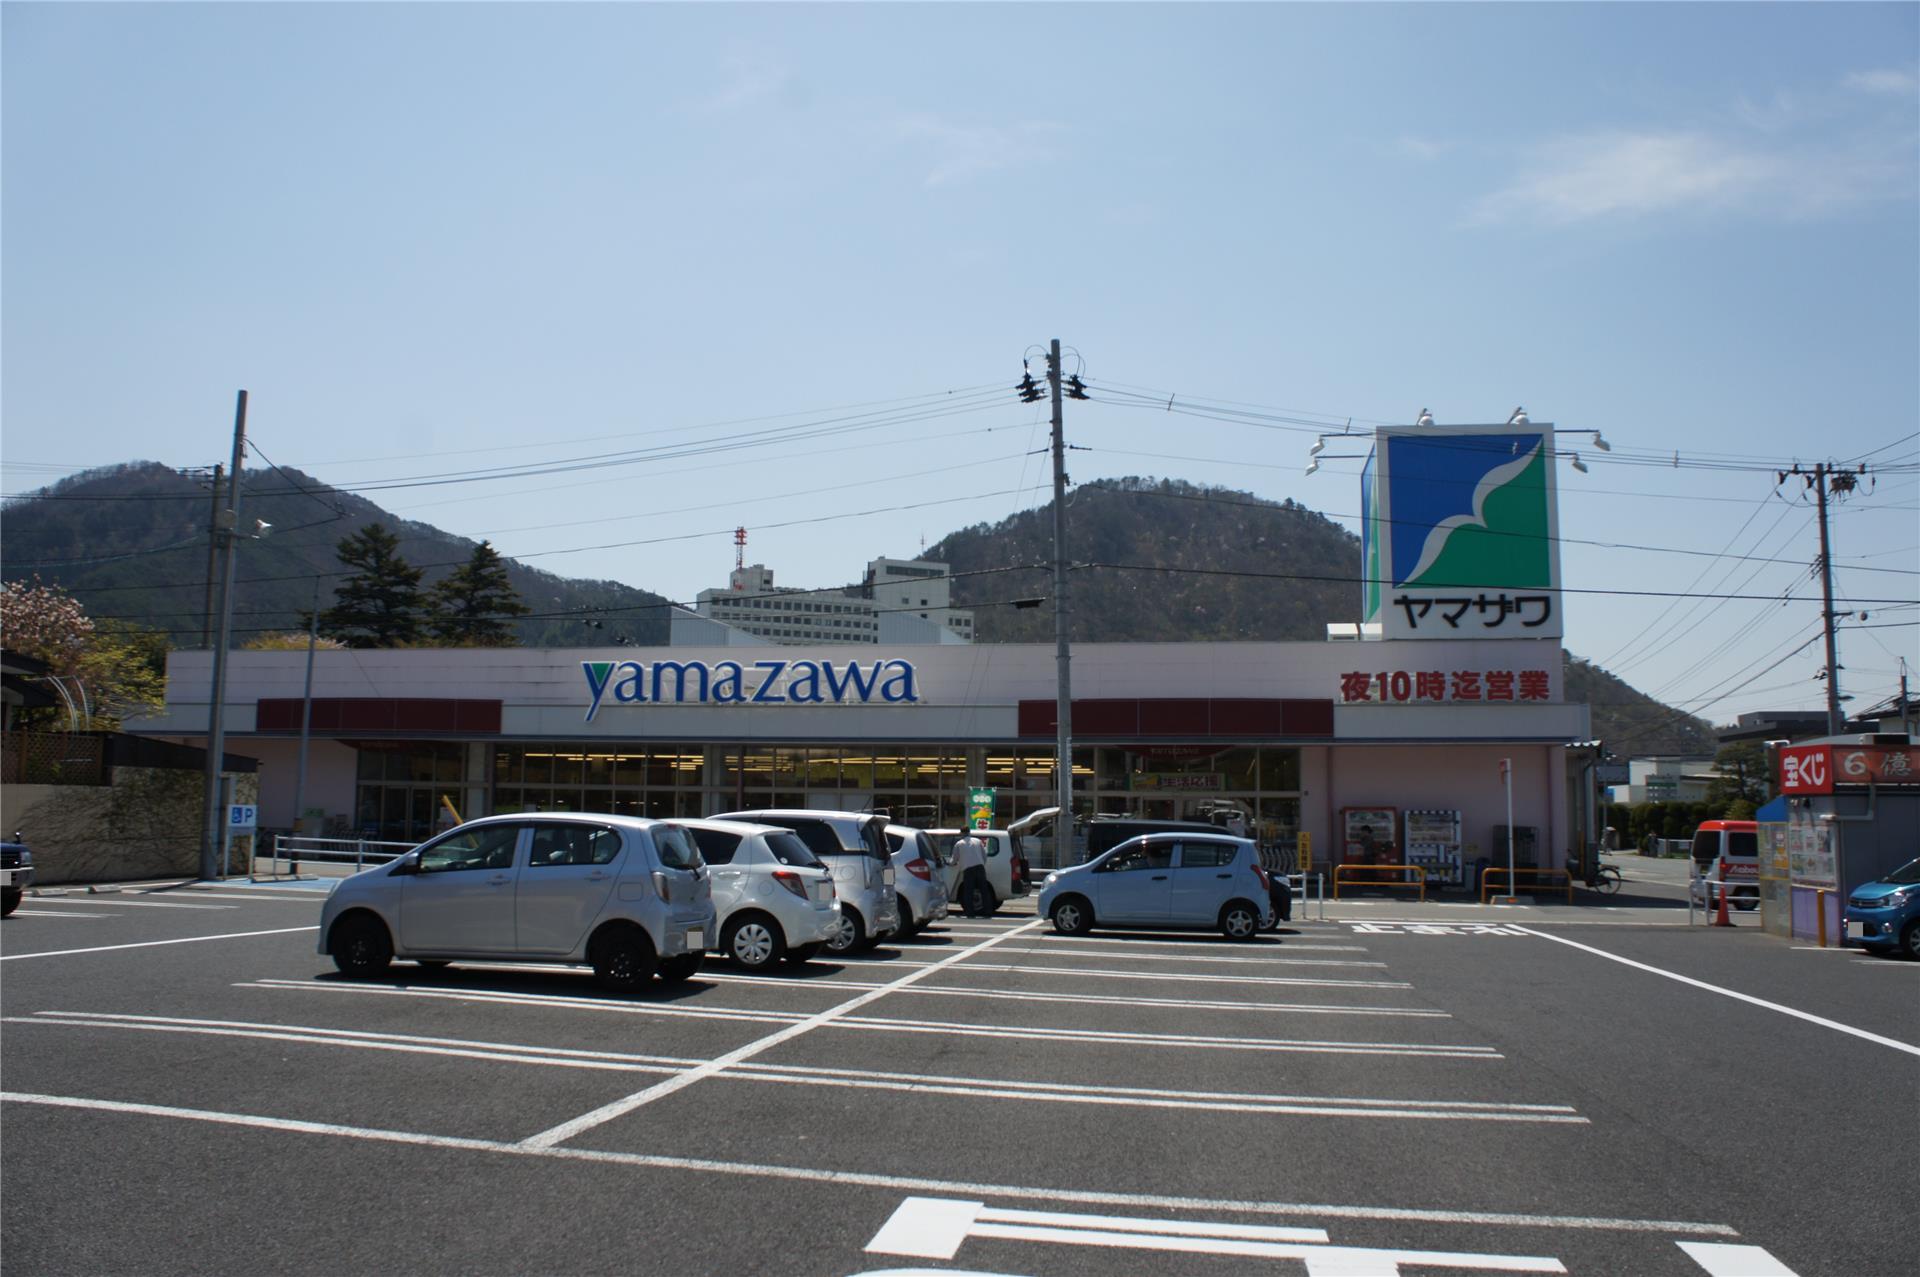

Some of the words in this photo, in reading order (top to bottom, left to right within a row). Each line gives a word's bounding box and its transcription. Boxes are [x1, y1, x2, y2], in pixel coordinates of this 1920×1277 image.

[1393, 594, 1551, 629] ヤマザワ
[580, 659, 920, 722] yamazawa
[1340, 670, 1551, 702] 夜10時迄営業
[1783, 752, 1826, 788] 宝くじ
[245, 808, 254, 823] P
